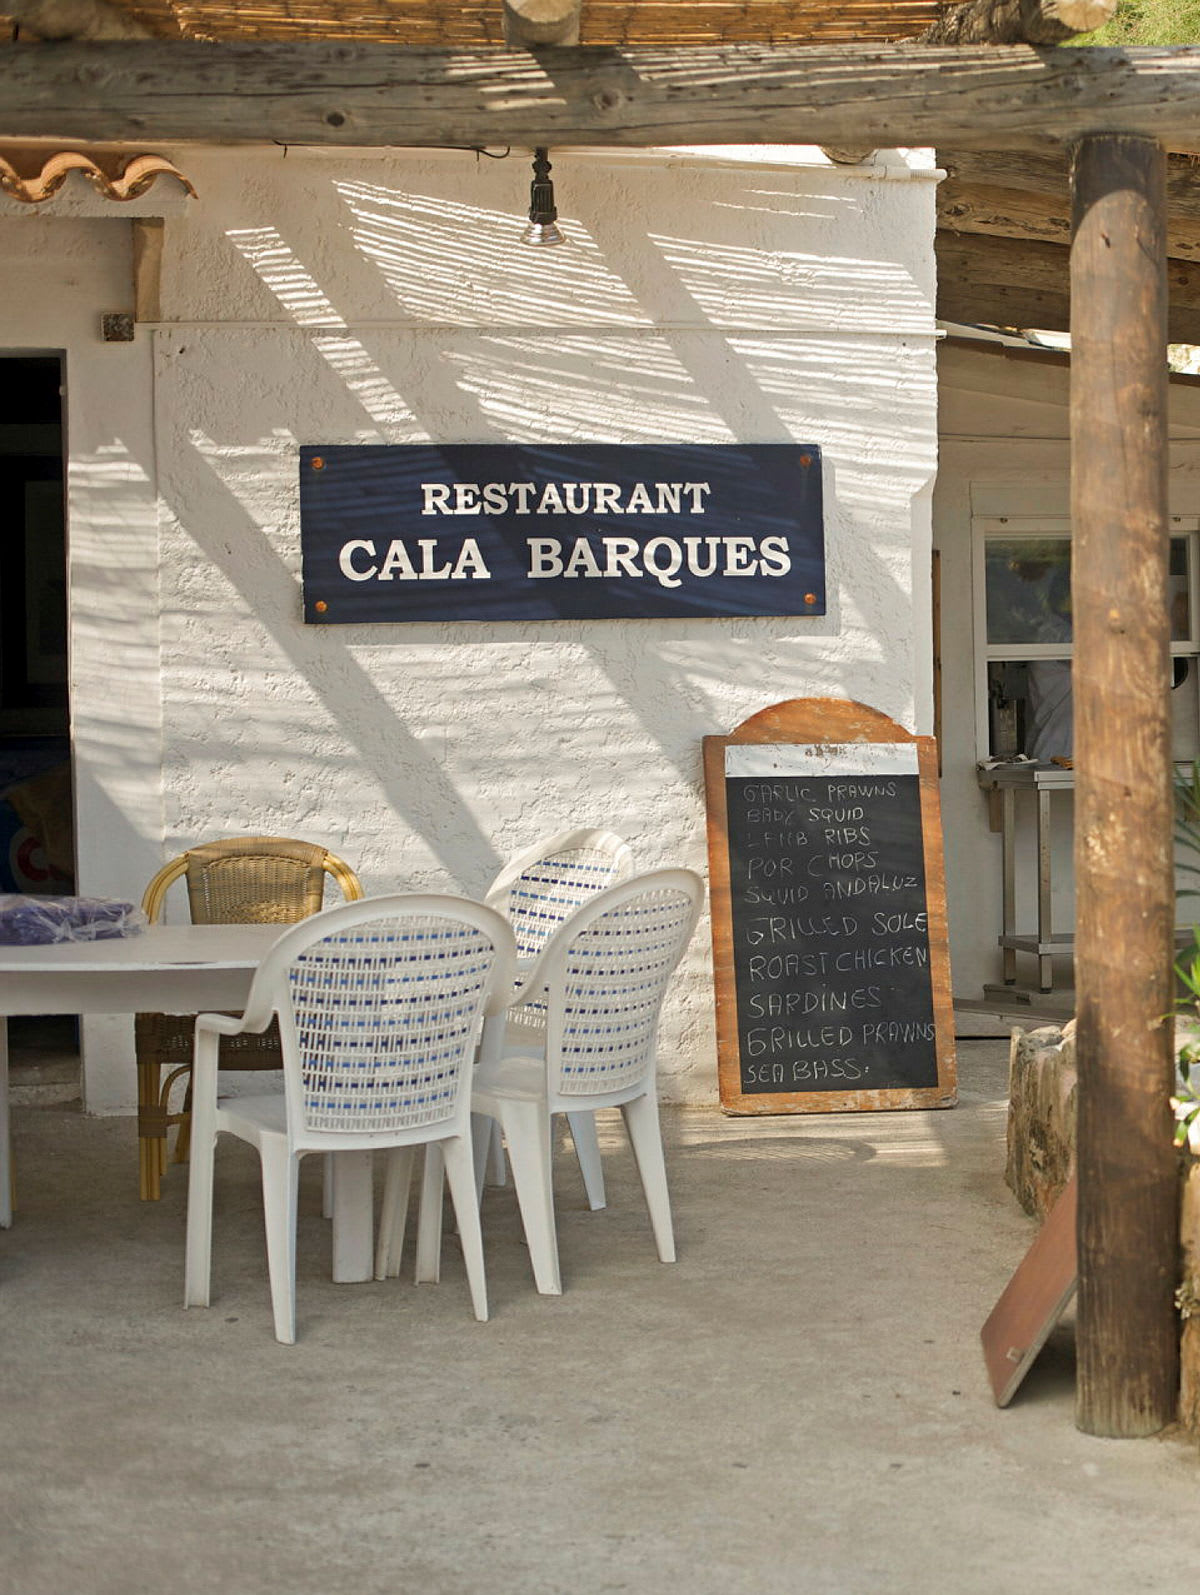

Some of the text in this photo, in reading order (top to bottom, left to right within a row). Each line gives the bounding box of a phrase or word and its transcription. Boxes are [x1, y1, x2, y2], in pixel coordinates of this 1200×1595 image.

[420, 482, 711, 515] RESTAURANT
[338, 536, 792, 588] CALA BARQUES
[743, 781, 897, 803] GARLIC PRAWNS
[808, 807, 864, 823] SQUID
[825, 826, 871, 846] RIBS
[744, 872, 919, 905] SQUID ANDALUZ
[747, 911, 928, 945] GRILLED SOLE
[749, 947, 928, 982] ROAST CHICKEN
[748, 986, 882, 1019] SARDINES
[747, 1021, 936, 1057] GRILLED PRAWNS
[744, 1063, 784, 1085] SEA
